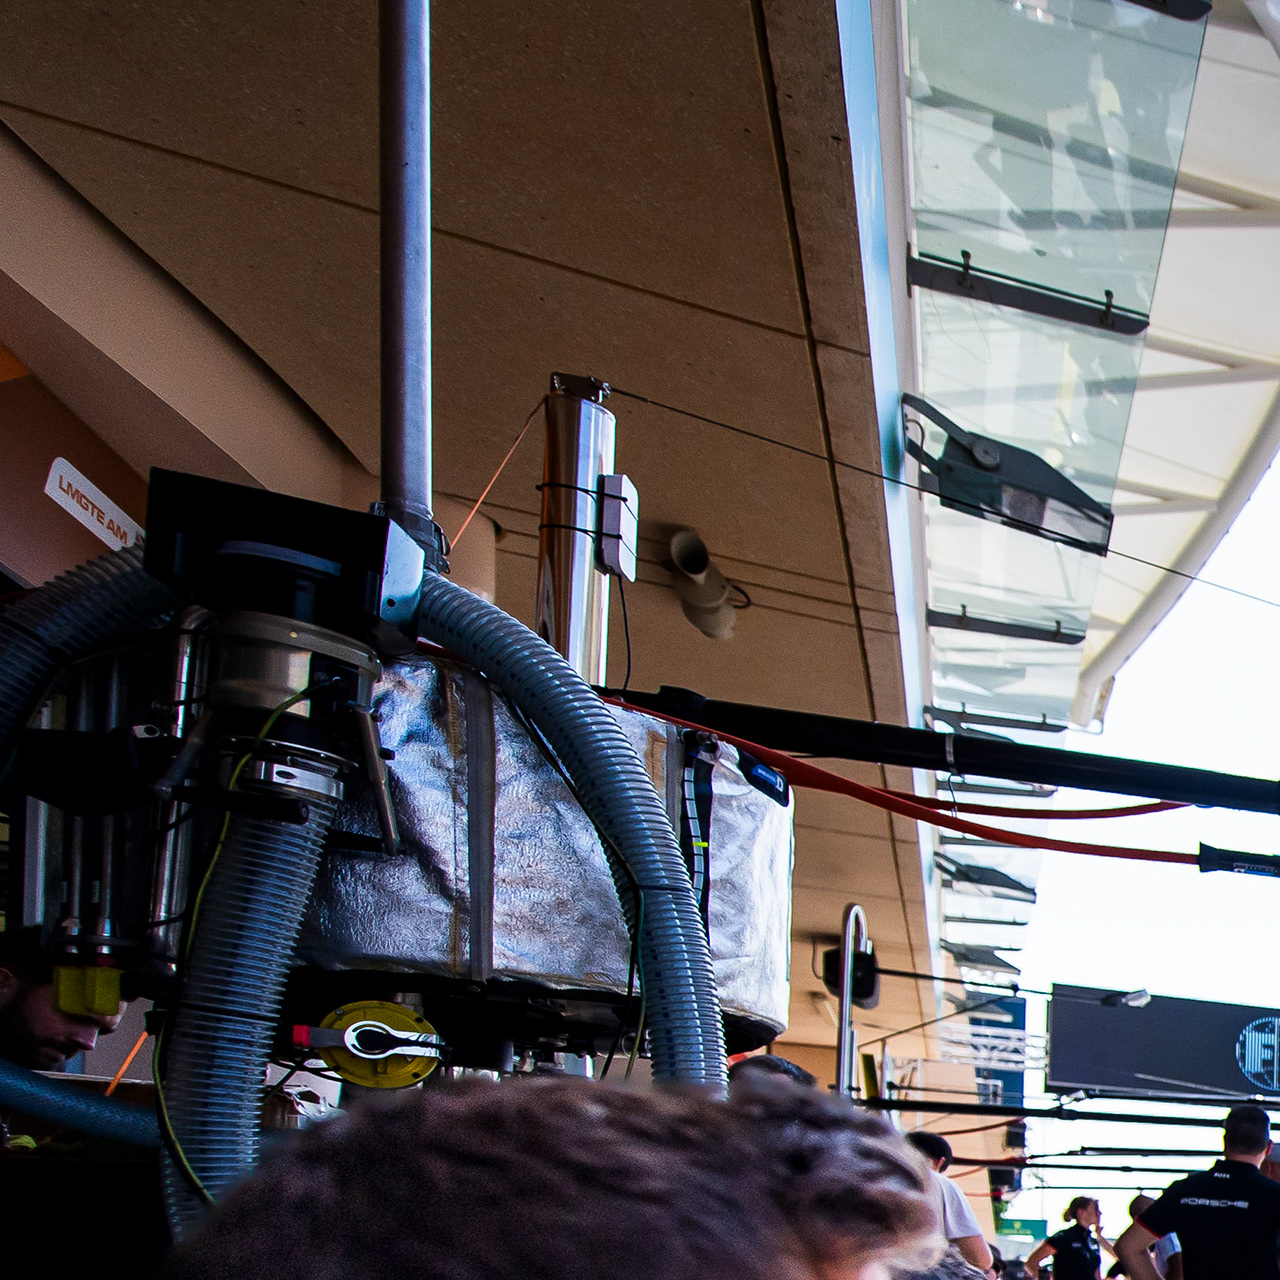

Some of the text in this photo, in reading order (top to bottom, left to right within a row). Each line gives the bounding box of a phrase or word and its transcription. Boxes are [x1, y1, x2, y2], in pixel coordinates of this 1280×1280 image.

[58, 474, 128, 546] LMGTE AM
[1180, 1197, 1249, 1209] PORSCHE
